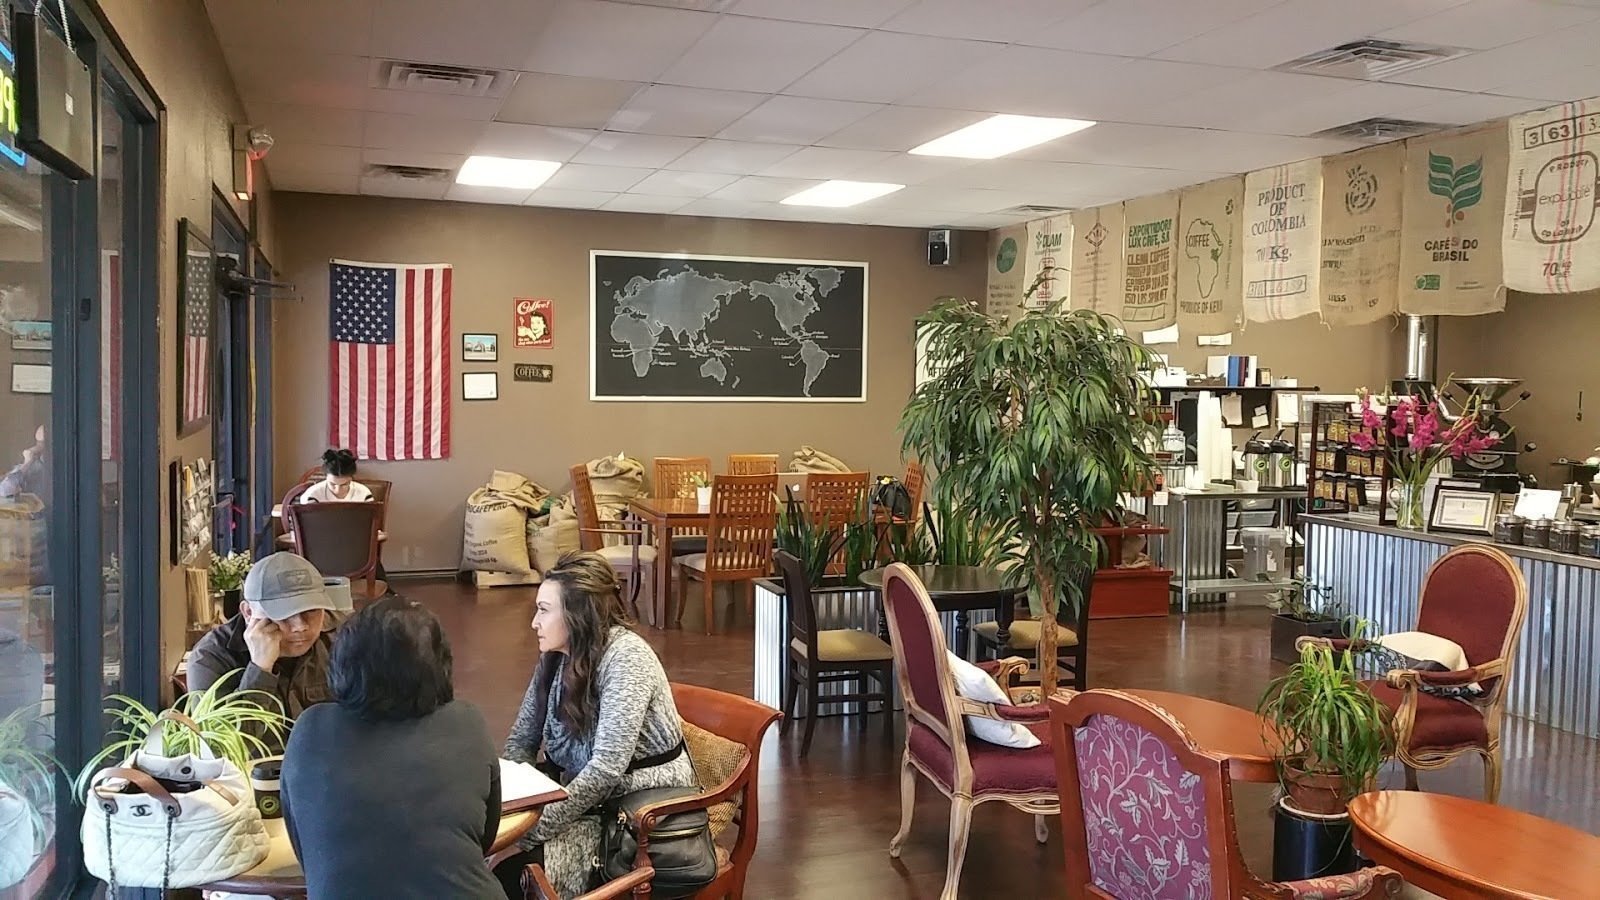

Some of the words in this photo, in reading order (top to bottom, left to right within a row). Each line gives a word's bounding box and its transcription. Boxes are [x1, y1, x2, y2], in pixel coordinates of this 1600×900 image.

[1529, 131, 1539, 145] 3
[1547, 124, 1570, 140] 63
[1257, 183, 1306, 207] PRODUCT
[1269, 201, 1287, 217] OF
[1251, 214, 1306, 236] COLOMBIA
[1128, 236, 1141, 248] LUX
[1188, 233, 1210, 248] COFFEE
[1424, 236, 1459, 251] CAFÉS
[1462, 239, 1479, 250] DO
[1432, 250, 1470, 262] BRASIL
[1543, 262, 1559, 277] 70
